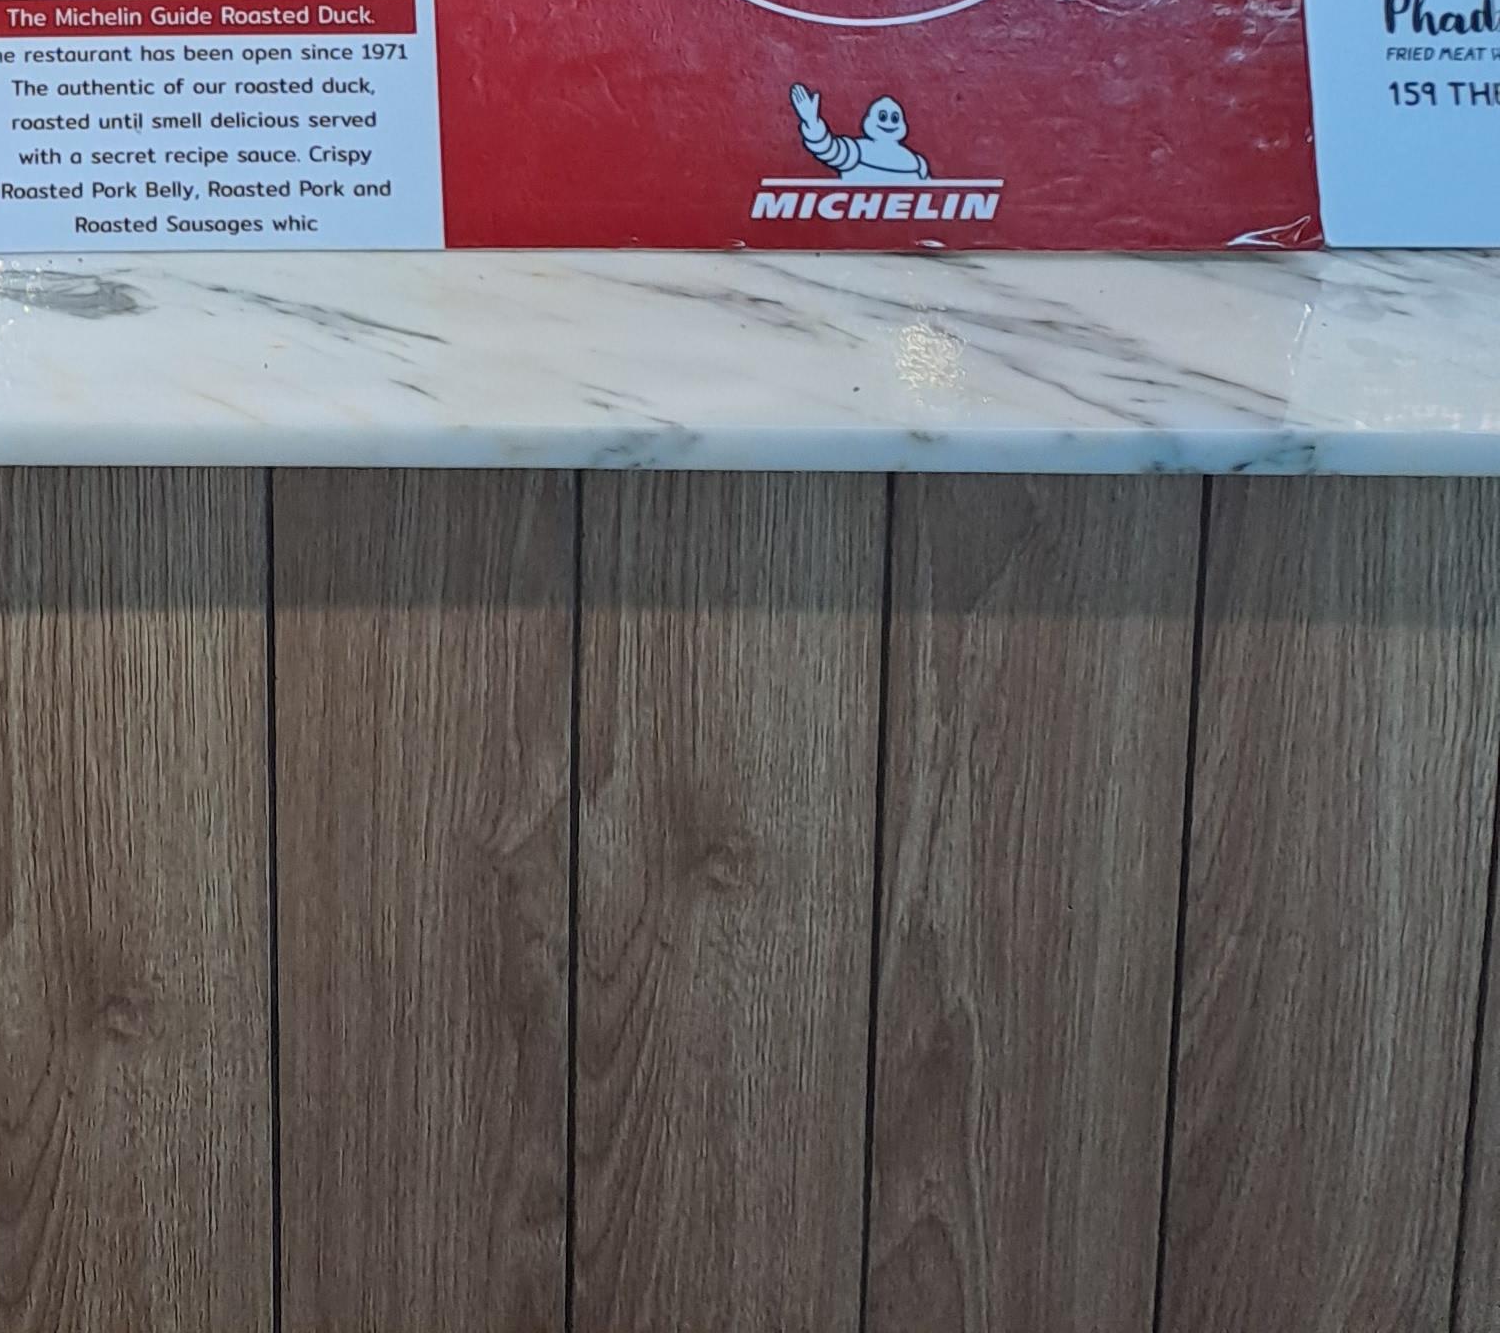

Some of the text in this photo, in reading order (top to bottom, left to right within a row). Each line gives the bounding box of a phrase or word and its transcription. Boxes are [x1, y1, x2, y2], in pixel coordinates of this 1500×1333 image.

[6, 5, 375, 27] The Michelin Guide Roasted Duck.
[24, 46, 132, 63] restaurant
[140, 45, 175, 62] has
[183, 44, 234, 62] been
[241, 48, 292, 65] open
[301, 44, 353, 61] since
[362, 43, 408, 60] 1971
[1387, 47, 1435, 61] FRIED
[1439, 47, 1487, 61] MEAT
[11, 77, 375, 97] The authentic of our roasted duck,
[1389, 81, 1437, 106] 159
[12, 111, 377, 131] roasted until smell delicious served
[18, 145, 372, 167] with a secret recipe sauce. Crispy
[1, 180, 392, 201] Roasted Pork Belly, Roasted Pork and
[751, 192, 1000, 219] MICHELIN
[75, 215, 318, 235] Roasted Sausages whic
